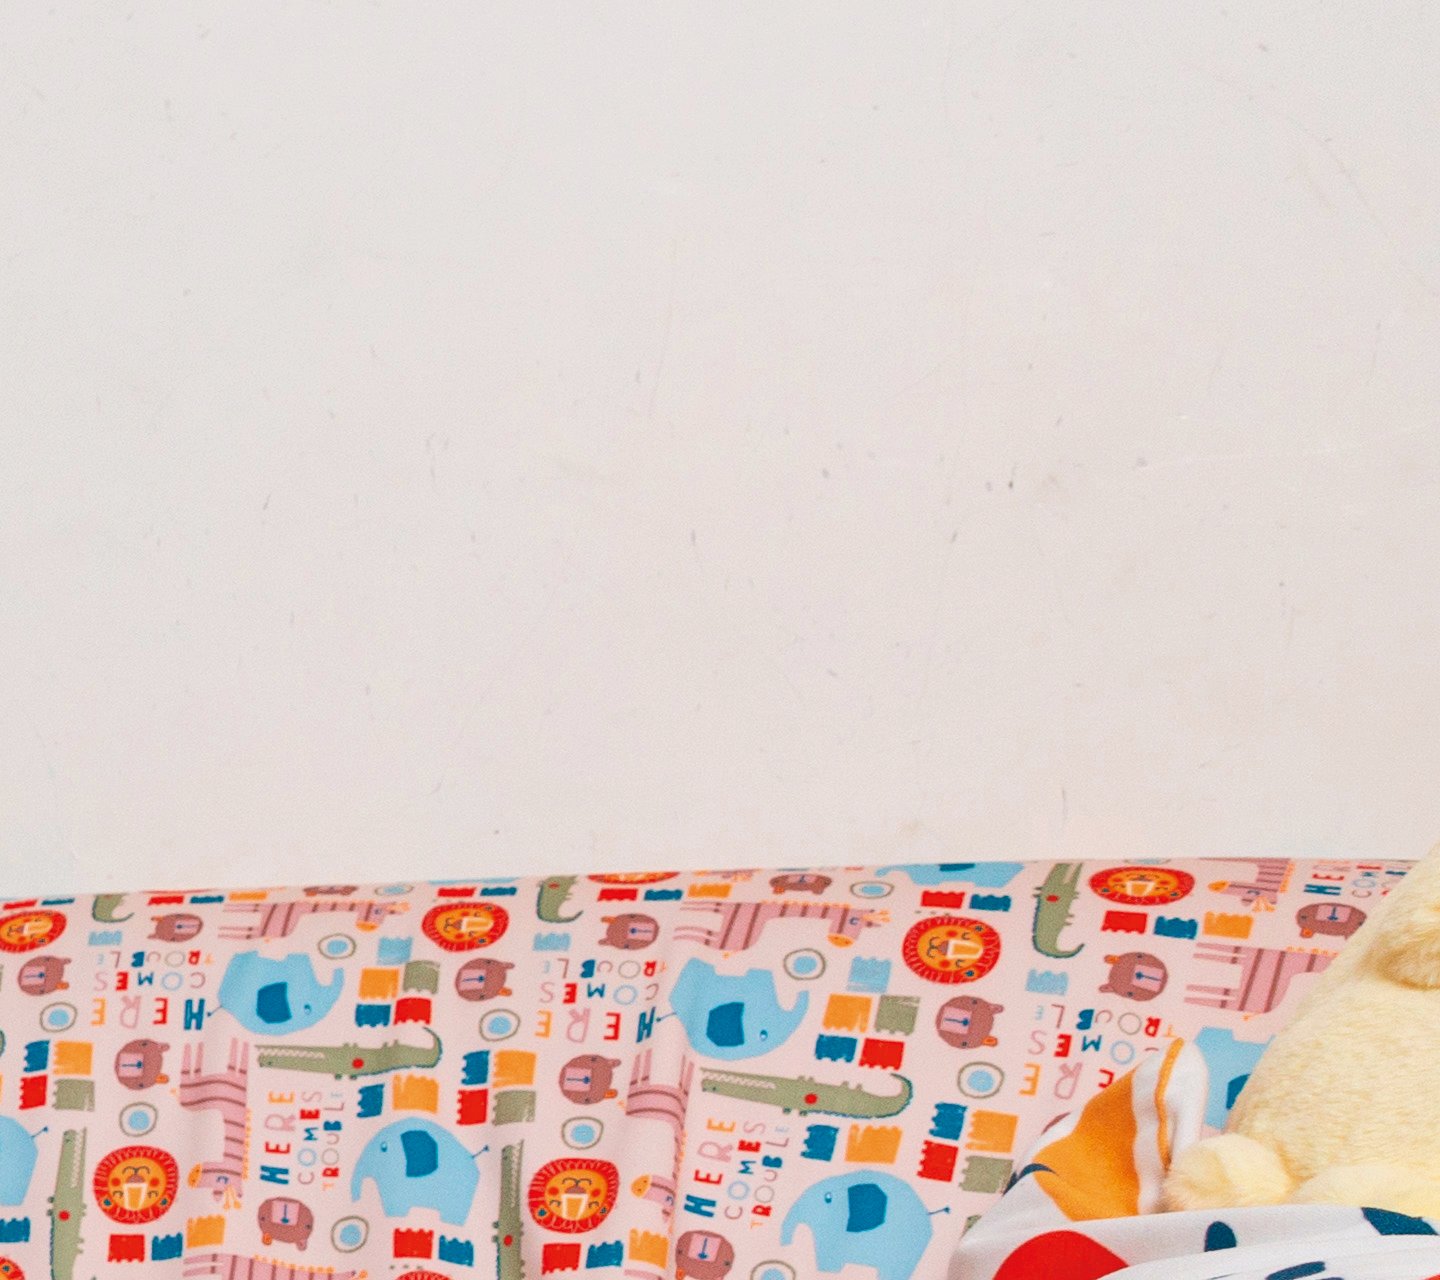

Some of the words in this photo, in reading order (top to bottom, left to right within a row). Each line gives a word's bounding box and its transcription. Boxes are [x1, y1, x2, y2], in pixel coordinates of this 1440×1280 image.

[90, 995, 206, 1031] HERE
[93, 971, 206, 991] COMES
[539, 982, 659, 1005] COMES
[534, 1006, 656, 1043] HERE
[259, 1091, 296, 1185] HERE
[297, 1091, 323, 1185] COMES
[683, 1117, 736, 1217] HERE
[724, 1121, 765, 1219] COMES
